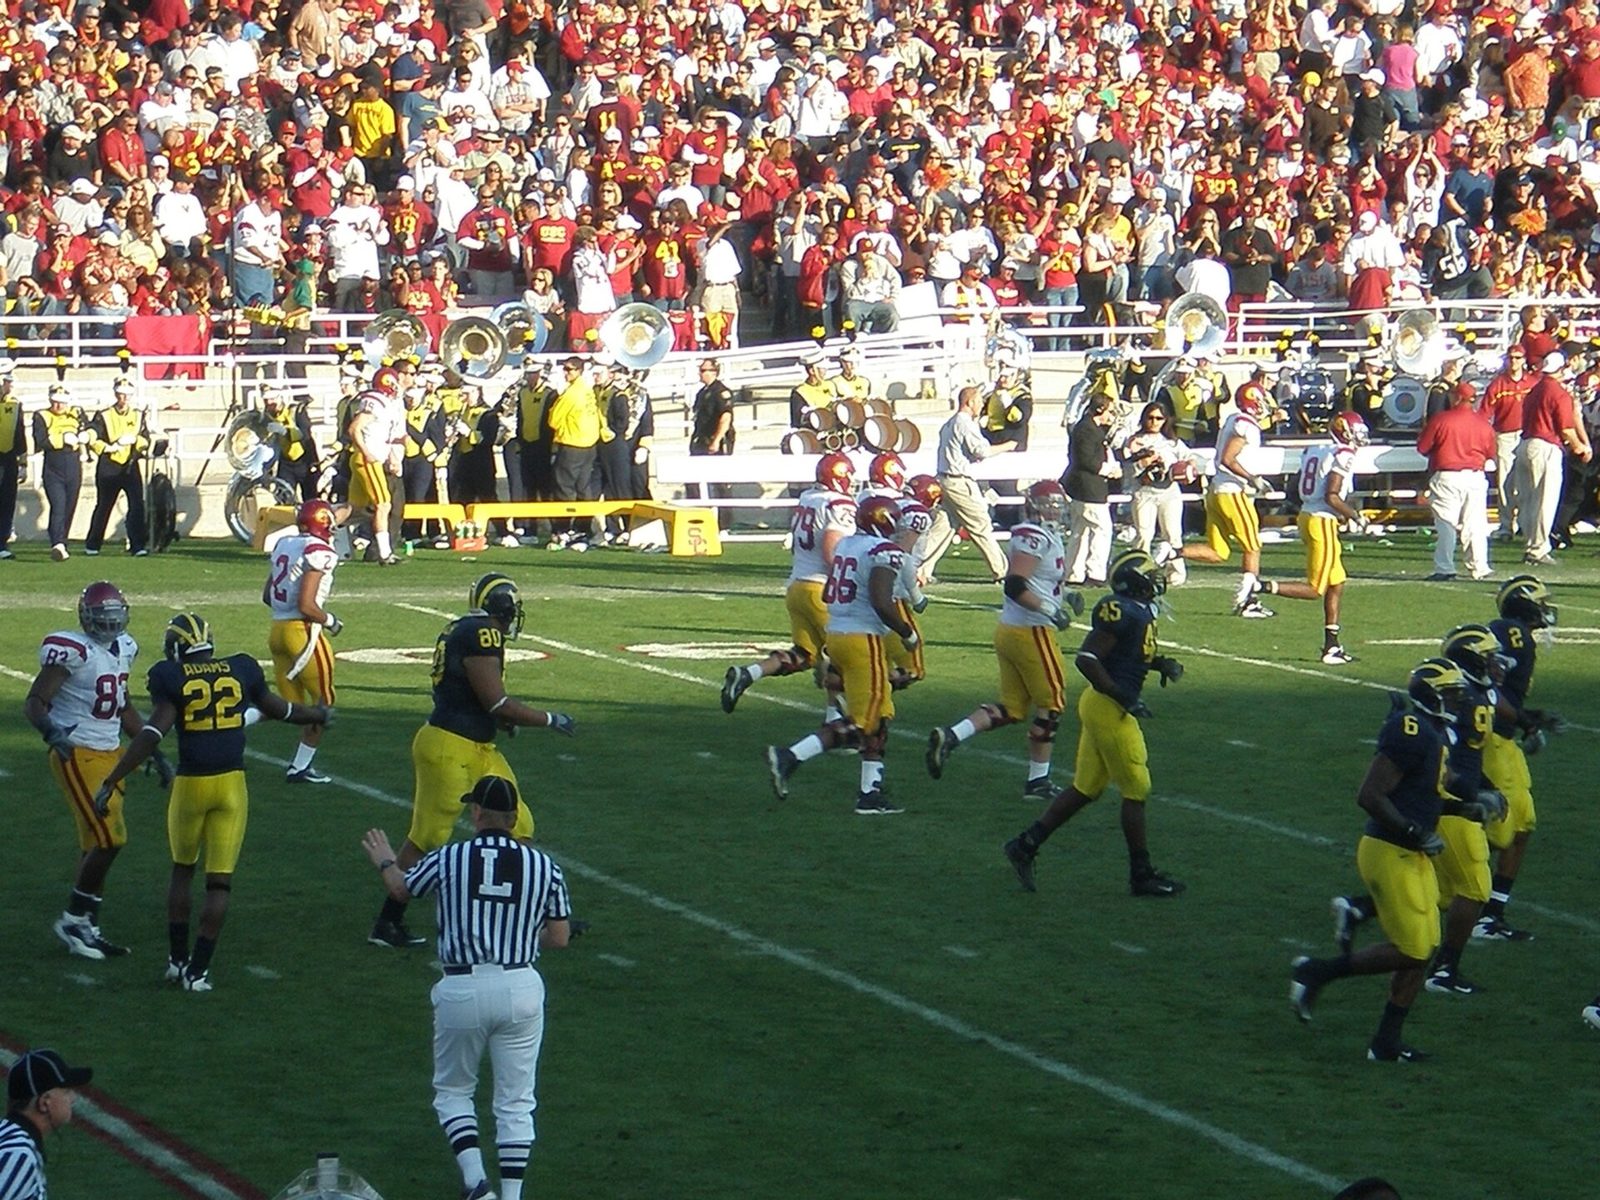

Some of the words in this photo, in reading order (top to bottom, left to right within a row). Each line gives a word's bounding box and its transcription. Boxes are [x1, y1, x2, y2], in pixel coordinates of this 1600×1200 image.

[655, 240, 682, 264] 41
[1302, 456, 1319, 496] 8
[910, 514, 929, 531] 60
[322, 555, 332, 571] 2
[272, 554, 290, 603] 2
[822, 554, 858, 605] 66
[1099, 601, 1122, 622] 45
[479, 627, 502, 648] 80
[1508, 627, 1524, 648] 2
[183, 661, 231, 676] ADAMS
[182, 676, 243, 731] 22
[1403, 714, 1420, 736] 6
[478, 848, 513, 898] L
